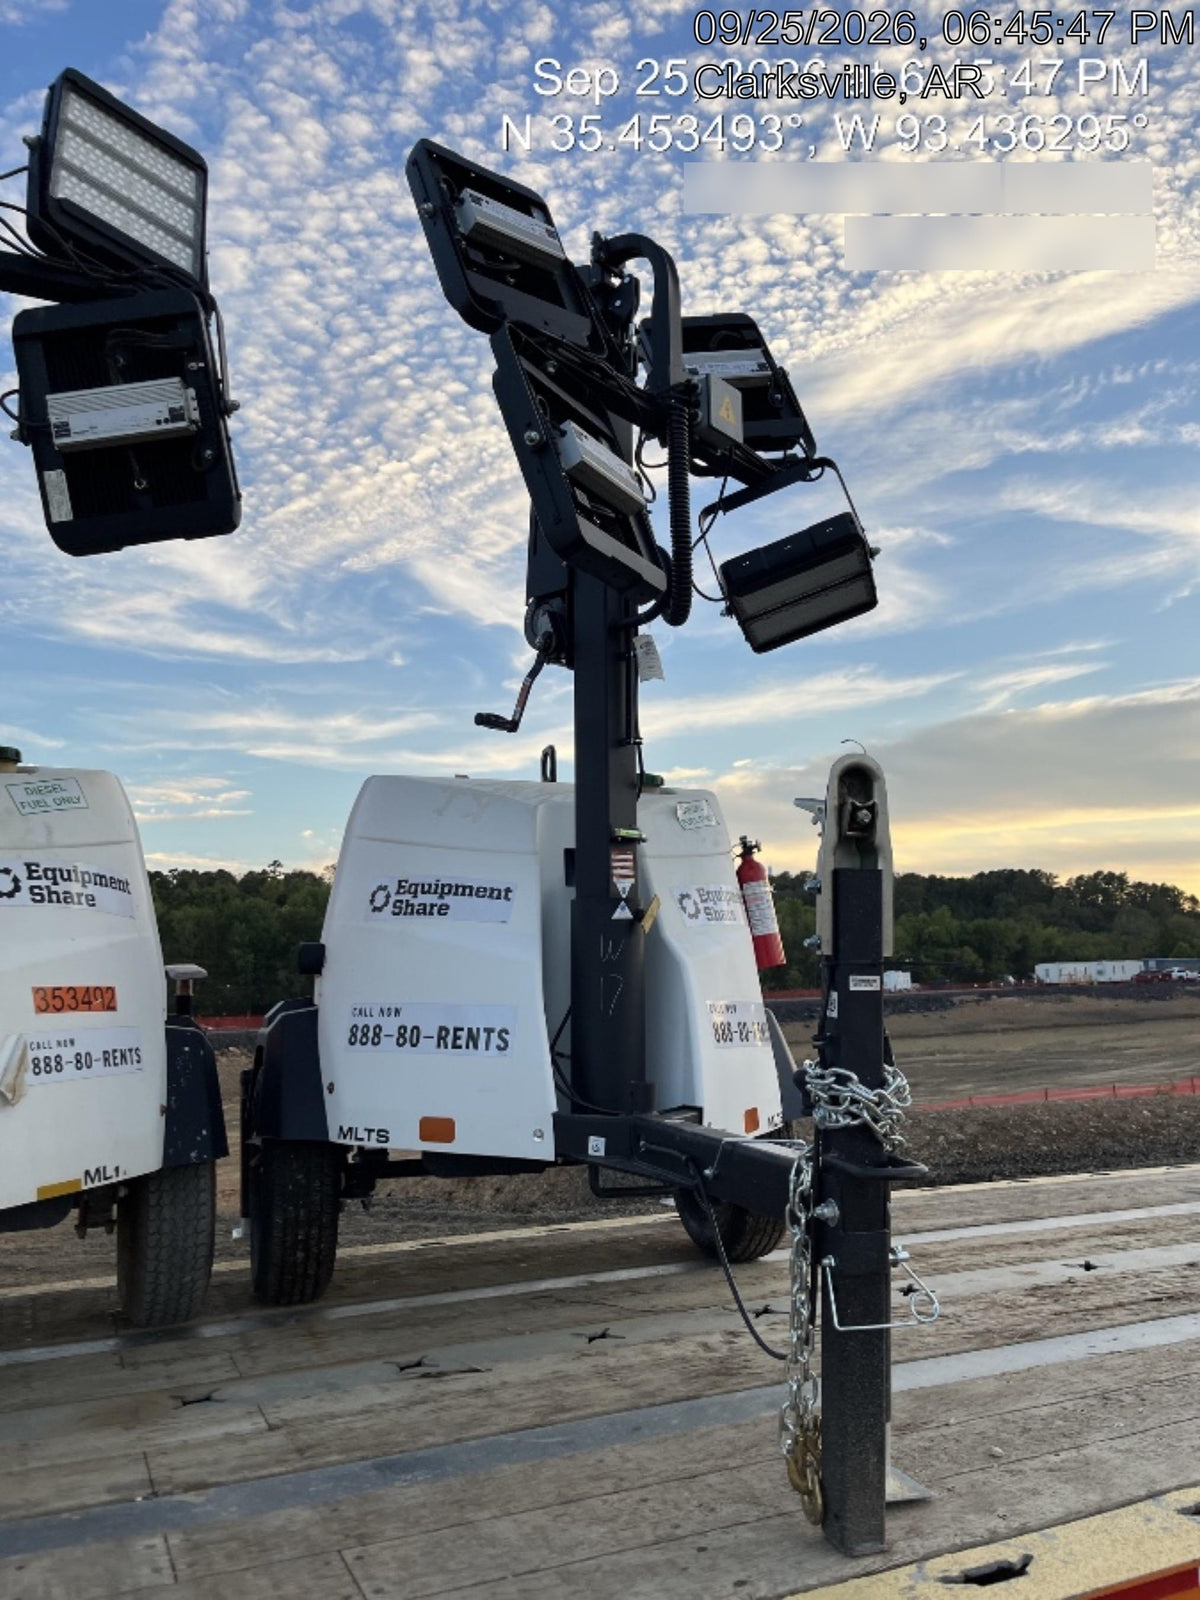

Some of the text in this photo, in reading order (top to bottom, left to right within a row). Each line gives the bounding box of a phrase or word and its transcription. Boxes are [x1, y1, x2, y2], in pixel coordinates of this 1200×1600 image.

[24, 784, 67, 796] DIESEL
[19, 795, 81, 809] FUEL ONLY
[24, 862, 132, 895] Equipment
[29, 885, 97, 907] Share
[394, 879, 513, 901] Equipment
[391, 899, 450, 917] Share
[34, 986, 116, 1012] 353492
[351, 1007, 402, 1018] CALL NOW
[29, 1038, 75, 1051] CALL NOW
[348, 1024, 510, 1052] 888-80-RENTS
[31, 1047, 142, 1076] 888-80-RENTS
[337, 1125, 390, 1144] MLTS
